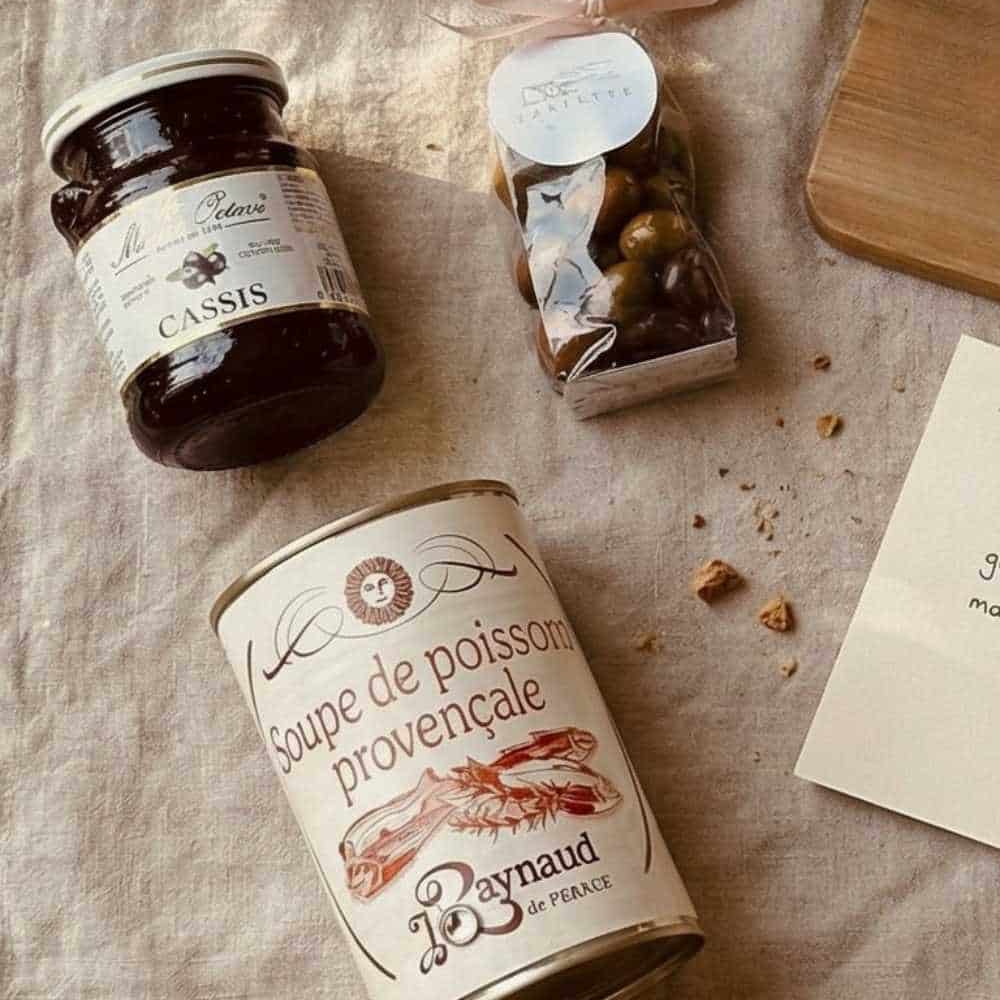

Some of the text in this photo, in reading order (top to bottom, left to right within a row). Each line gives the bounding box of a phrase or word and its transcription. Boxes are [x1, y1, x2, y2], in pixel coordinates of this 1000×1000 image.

[158, 282, 268, 338] CASSIS
[269, 687, 364, 775] Soupe
[366, 653, 421, 708] de
[331, 666, 547, 808] provençale
